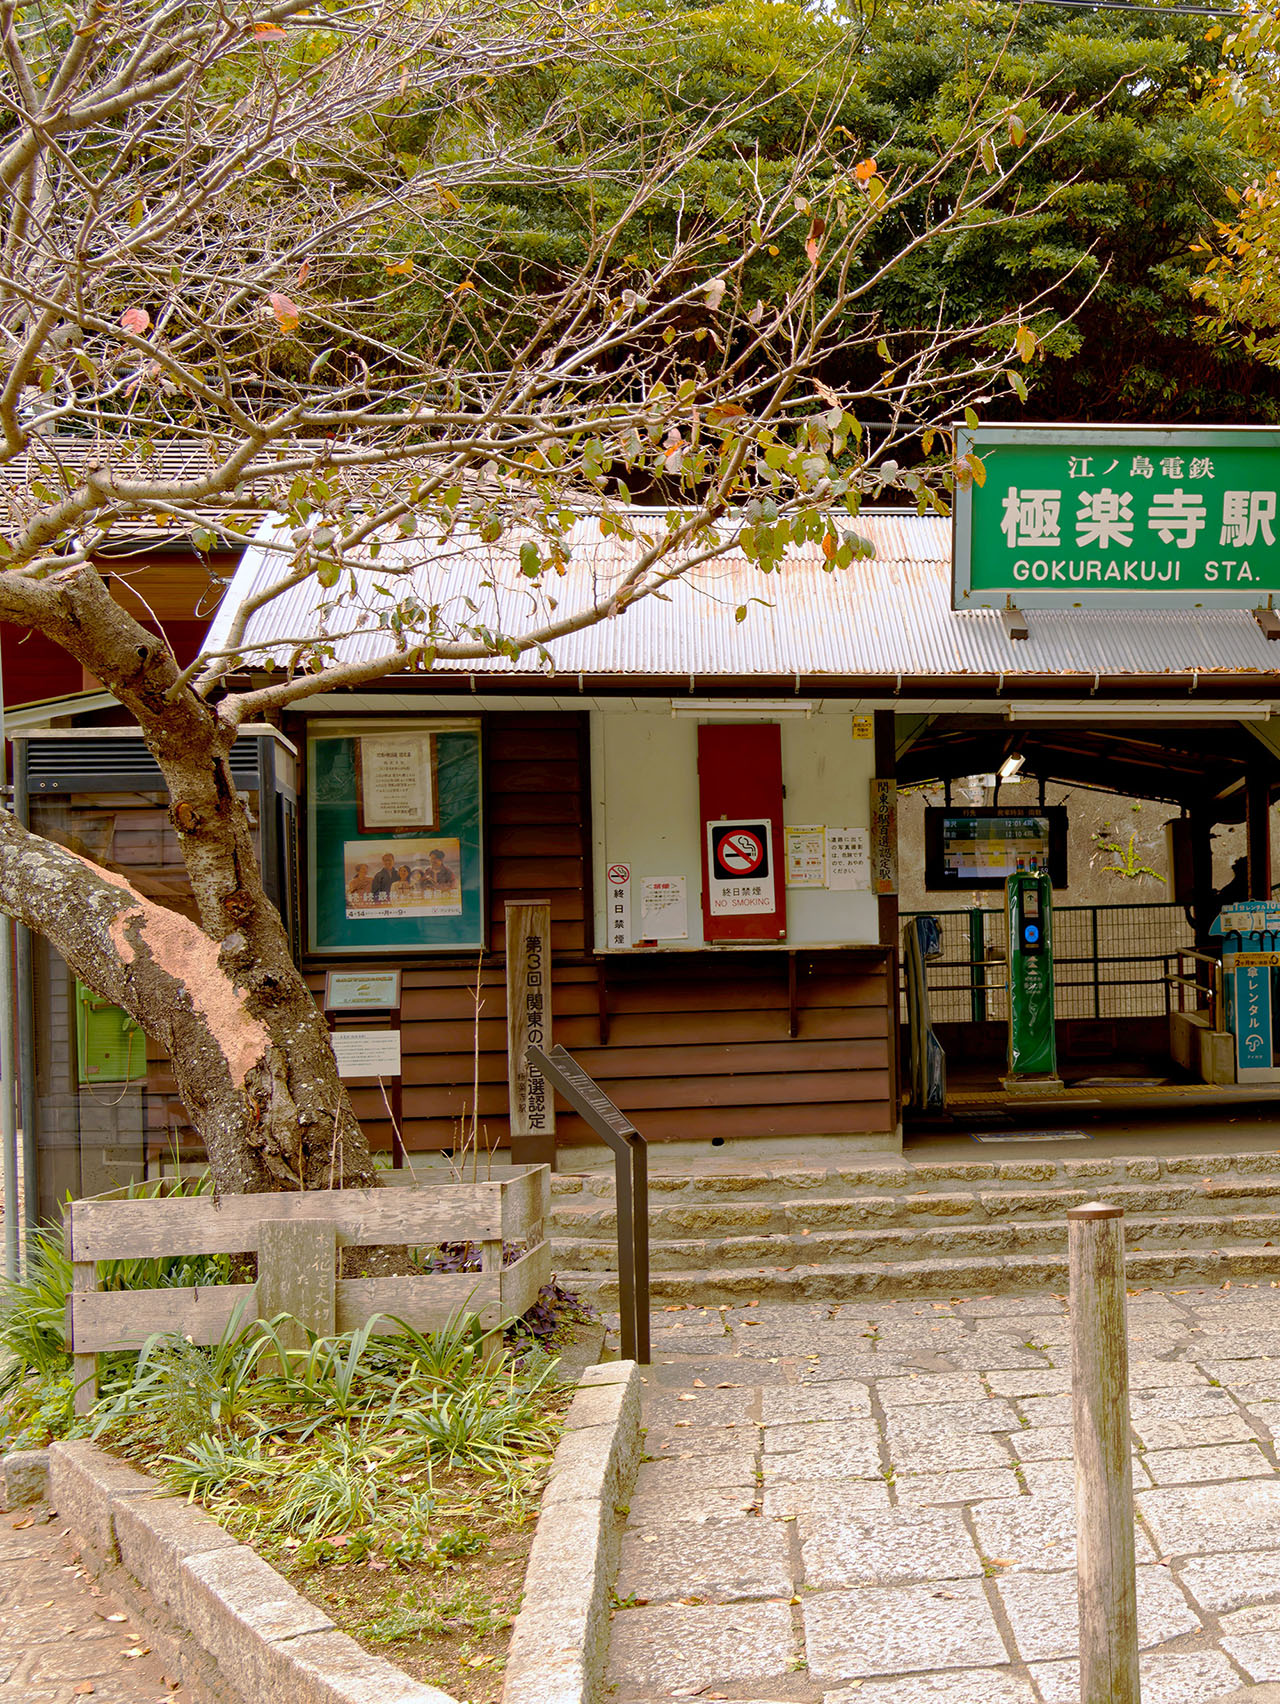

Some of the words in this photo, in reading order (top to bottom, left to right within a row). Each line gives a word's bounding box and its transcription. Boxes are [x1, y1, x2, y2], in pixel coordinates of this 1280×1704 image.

[1067, 455, 1216, 480] 江ノ島電鉄
[1000, 486, 1278, 550] 極楽寺駅
[1013, 560, 1181, 582] GOKURAKUJI
[1204, 560, 1261, 582] STA.
[714, 899, 728, 908] NO
[731, 897, 770, 907] SMOKING
[722, 885, 762, 897] 終日禁煙
[613, 888, 625, 945] 終日禁煙
[525, 935, 542, 987] 第3回
[526, 994, 546, 1130] 関東の百選認定
